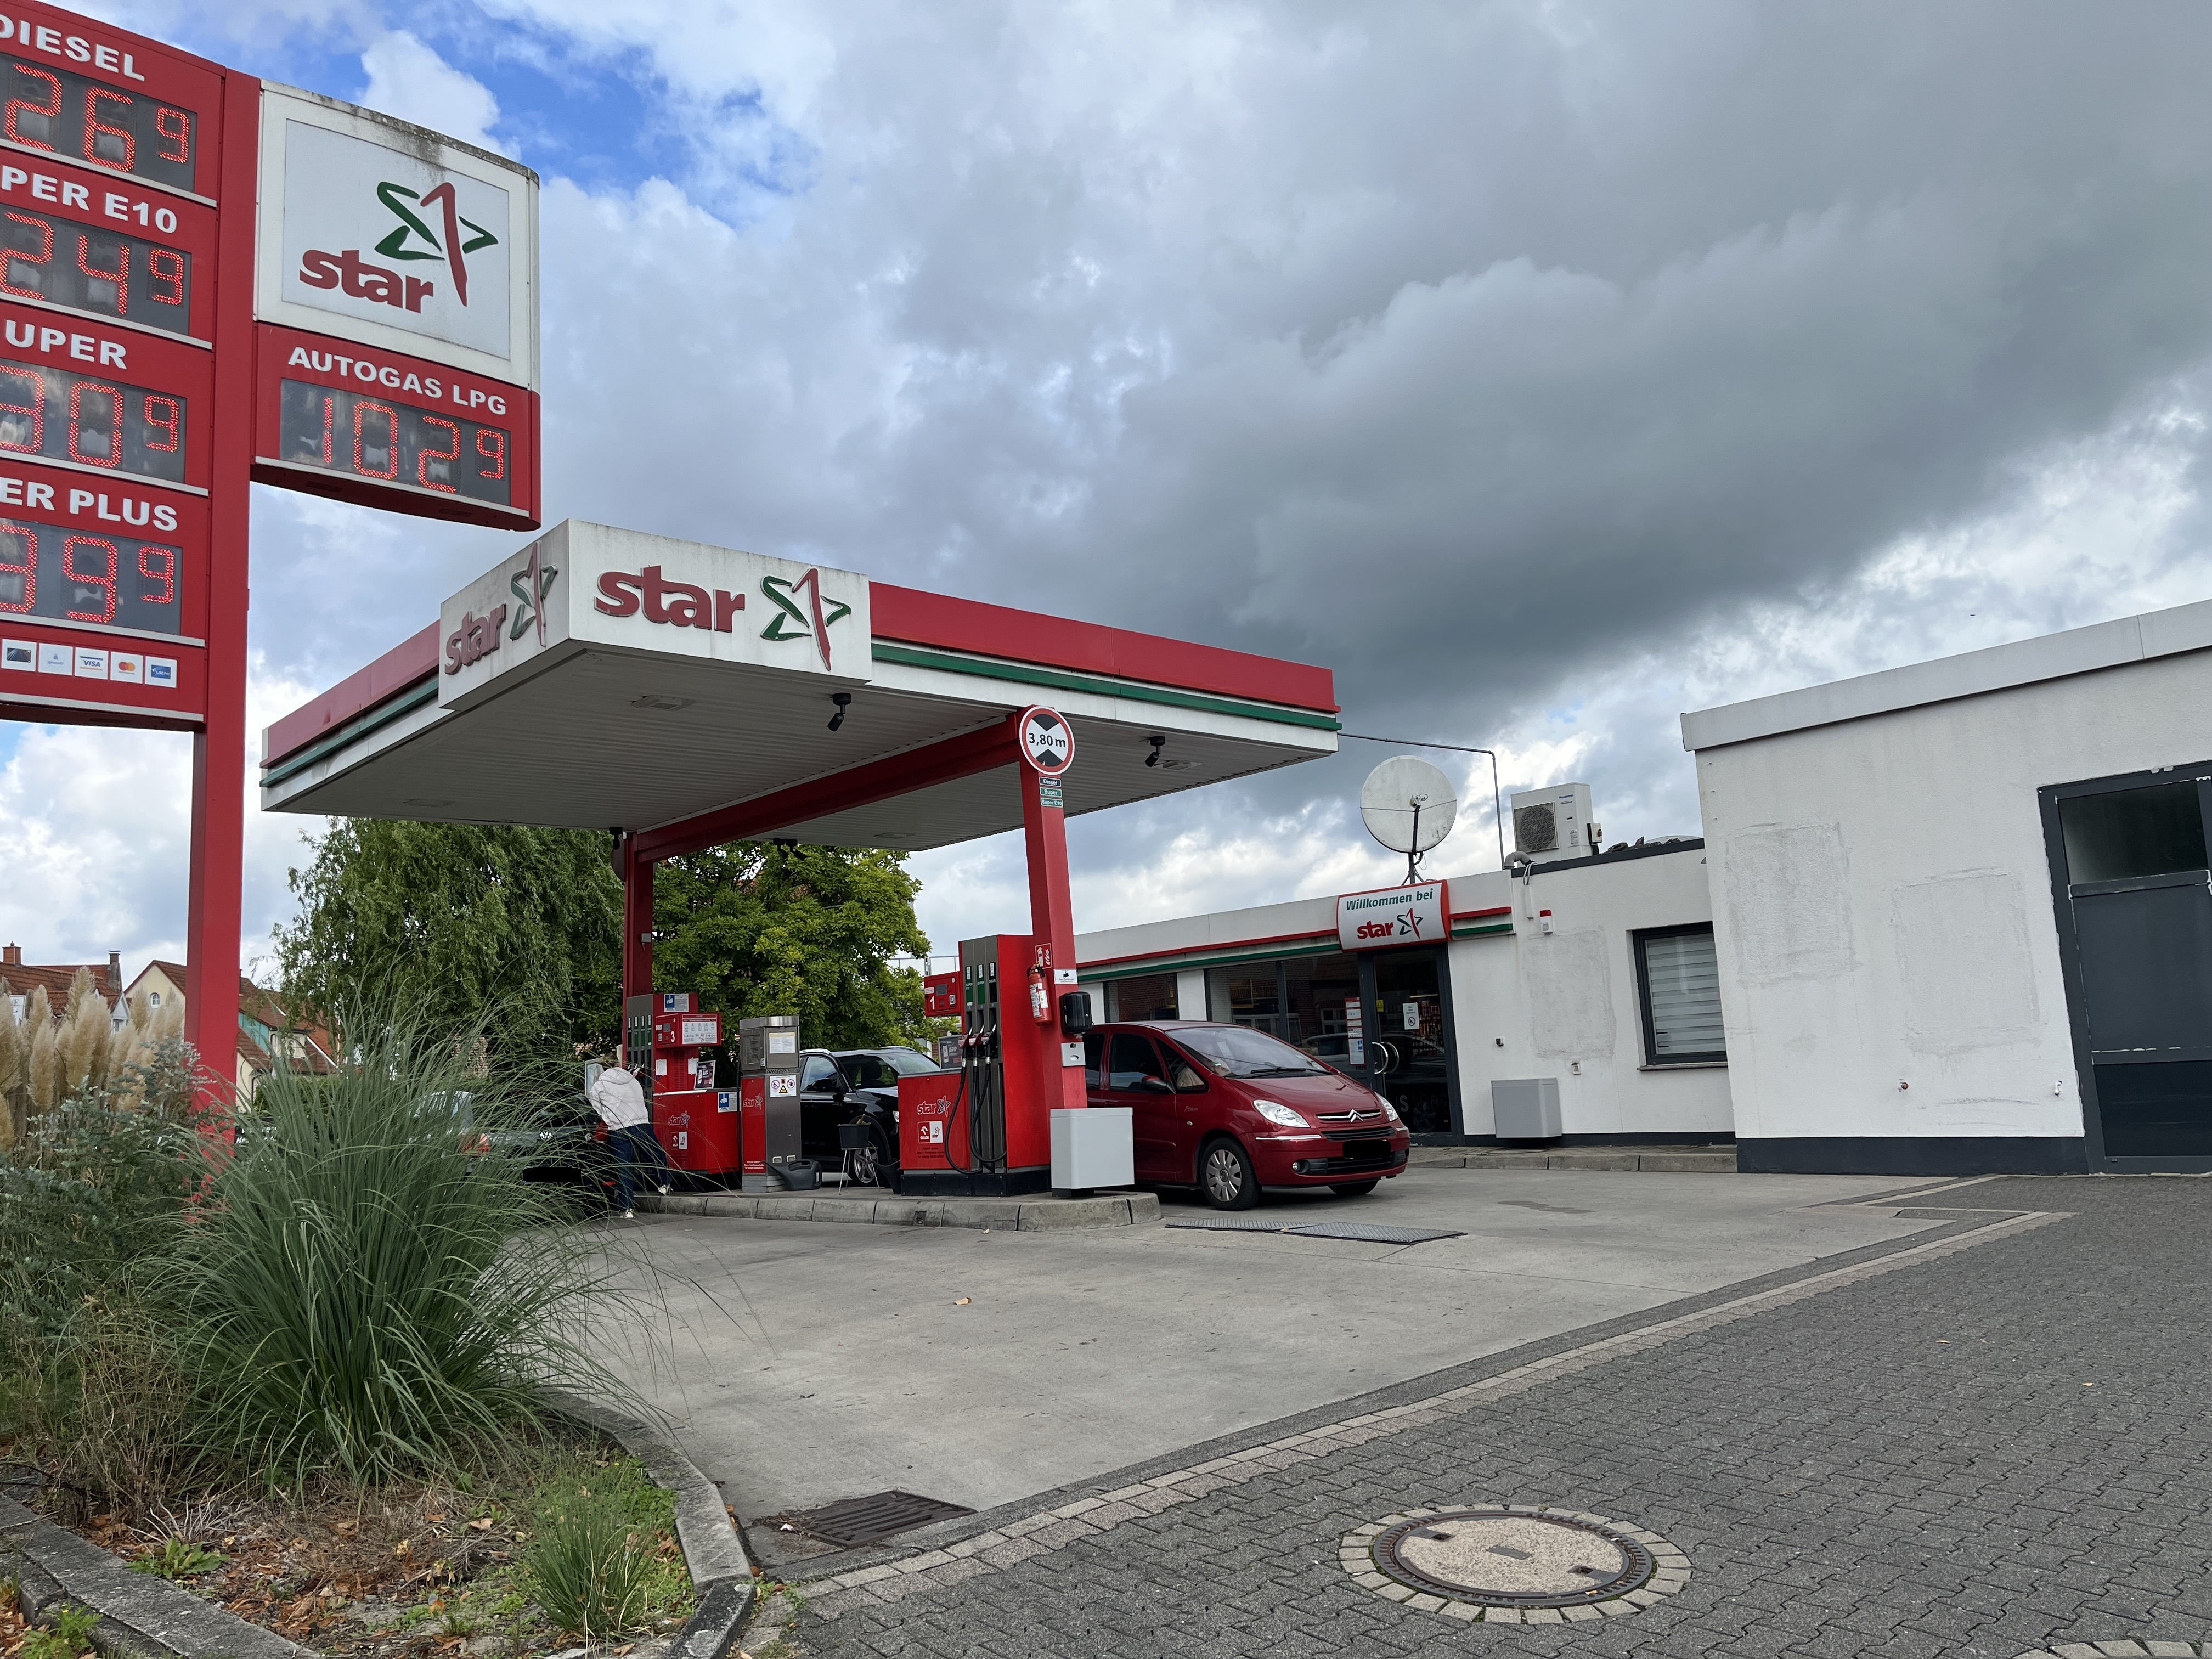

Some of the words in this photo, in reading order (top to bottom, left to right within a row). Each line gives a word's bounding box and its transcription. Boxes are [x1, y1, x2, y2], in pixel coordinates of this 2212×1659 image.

[0, 14, 145, 82] DIESEL
[105, 193, 177, 233] E10
[300, 250, 434, 314] star
[288, 346, 442, 398] AUTOGAS
[453, 384, 506, 415] LPG
[70, 488, 178, 531] PLUS
[594, 565, 745, 633] star
[445, 603, 506, 675] star
[1029, 732, 1053, 746] 3,80
[1055, 738, 1066, 747] m
[1346, 894, 1412, 911] Willkommen
[1416, 888, 1434, 901] bei
[1357, 921, 1393, 939] star
[930, 996, 935, 1010] 1
[670, 1031, 675, 1042] 3
[742, 1097, 755, 1108] star
[917, 1101, 937, 1115] star
[668, 1114, 682, 1126] star
